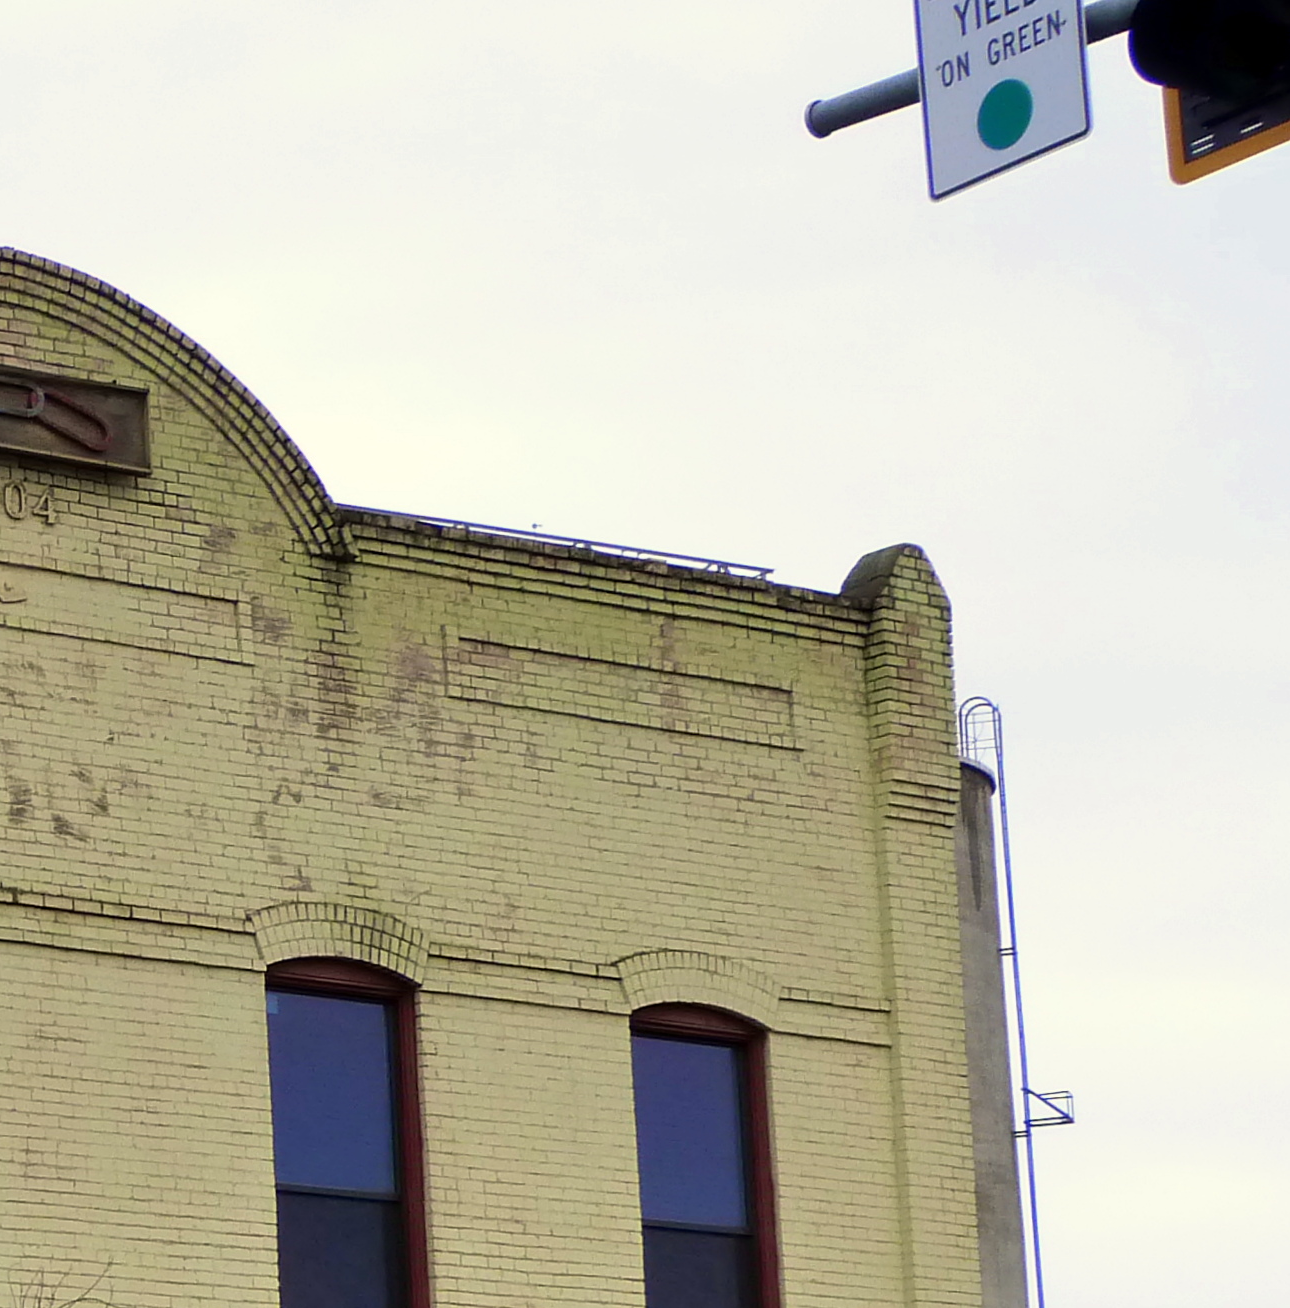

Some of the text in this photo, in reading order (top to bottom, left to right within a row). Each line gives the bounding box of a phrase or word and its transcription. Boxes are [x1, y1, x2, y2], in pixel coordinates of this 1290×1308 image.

[953, 0, 1036, 37] YIEL
[940, 9, 1062, 88] ON GREEN
